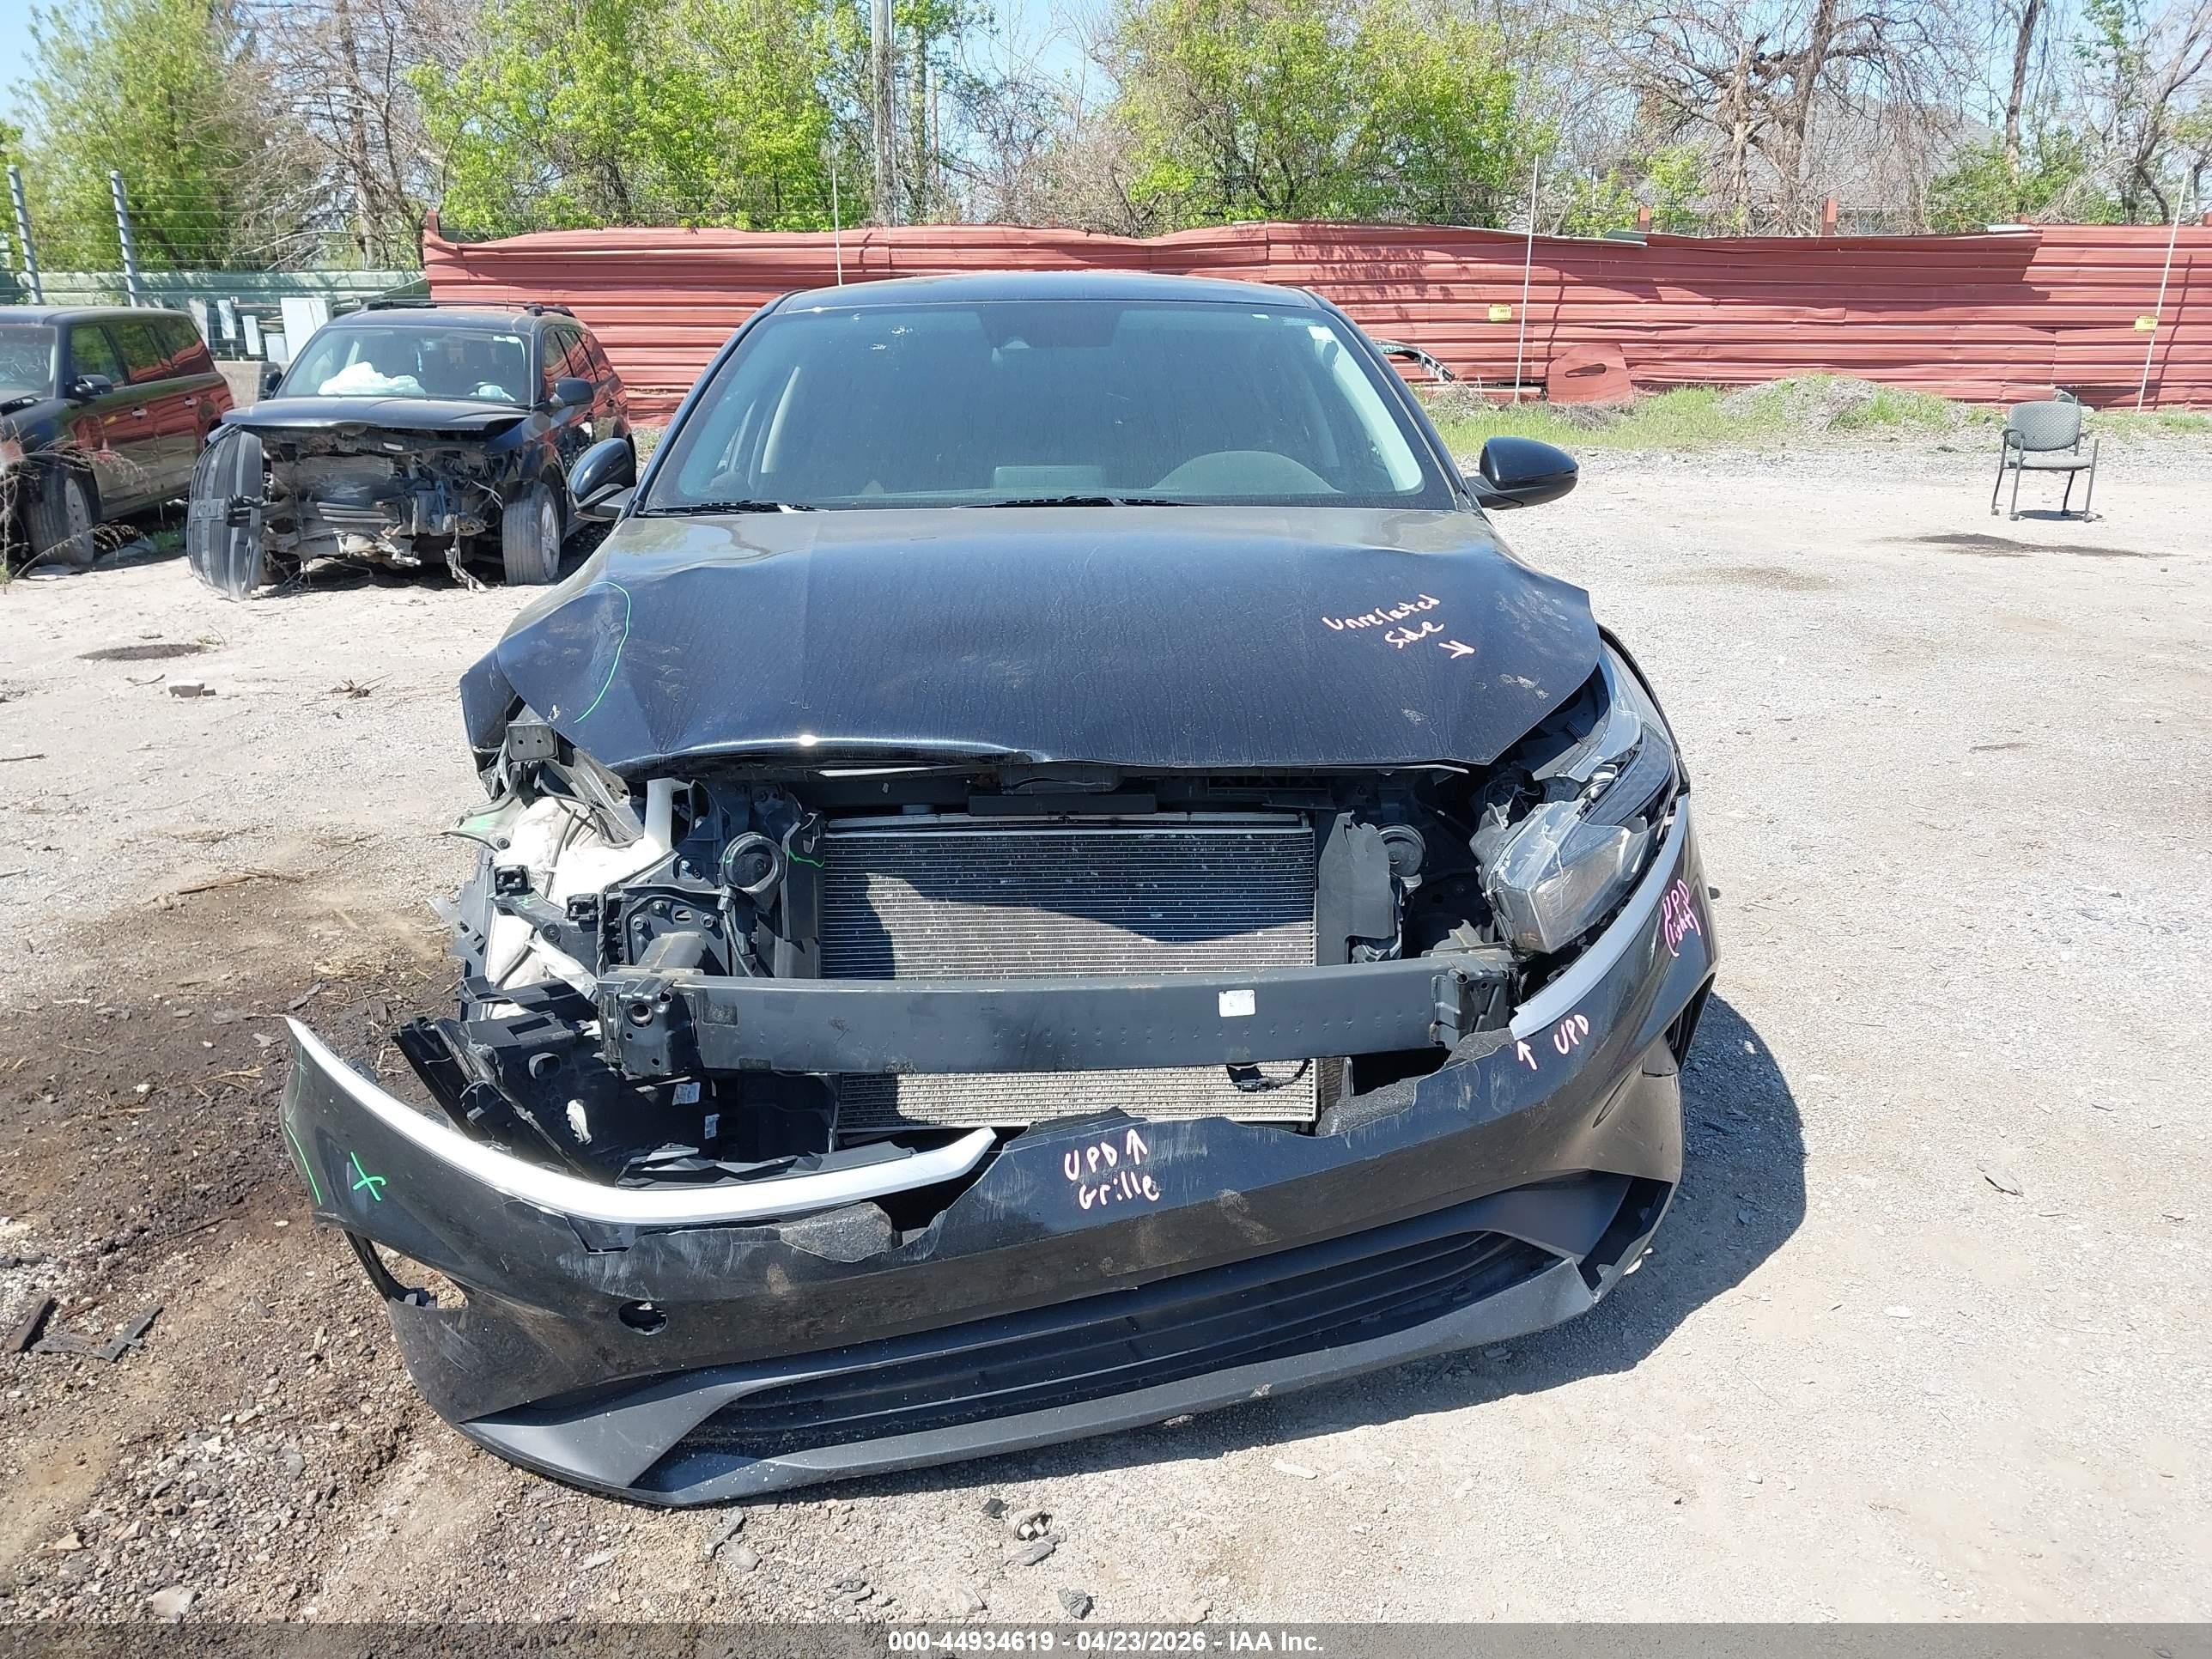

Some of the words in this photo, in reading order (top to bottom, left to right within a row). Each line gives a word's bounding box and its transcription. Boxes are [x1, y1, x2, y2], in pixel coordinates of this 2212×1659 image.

[1322, 593, 1441, 631] Unrelated
[1384, 620, 1445, 649] Side
[1662, 878, 1690, 921] UPD
[1553, 1014, 1589, 1054] UPD
[1064, 1141, 1118, 1181] UPD
[1079, 1170, 1160, 1210] Grille
